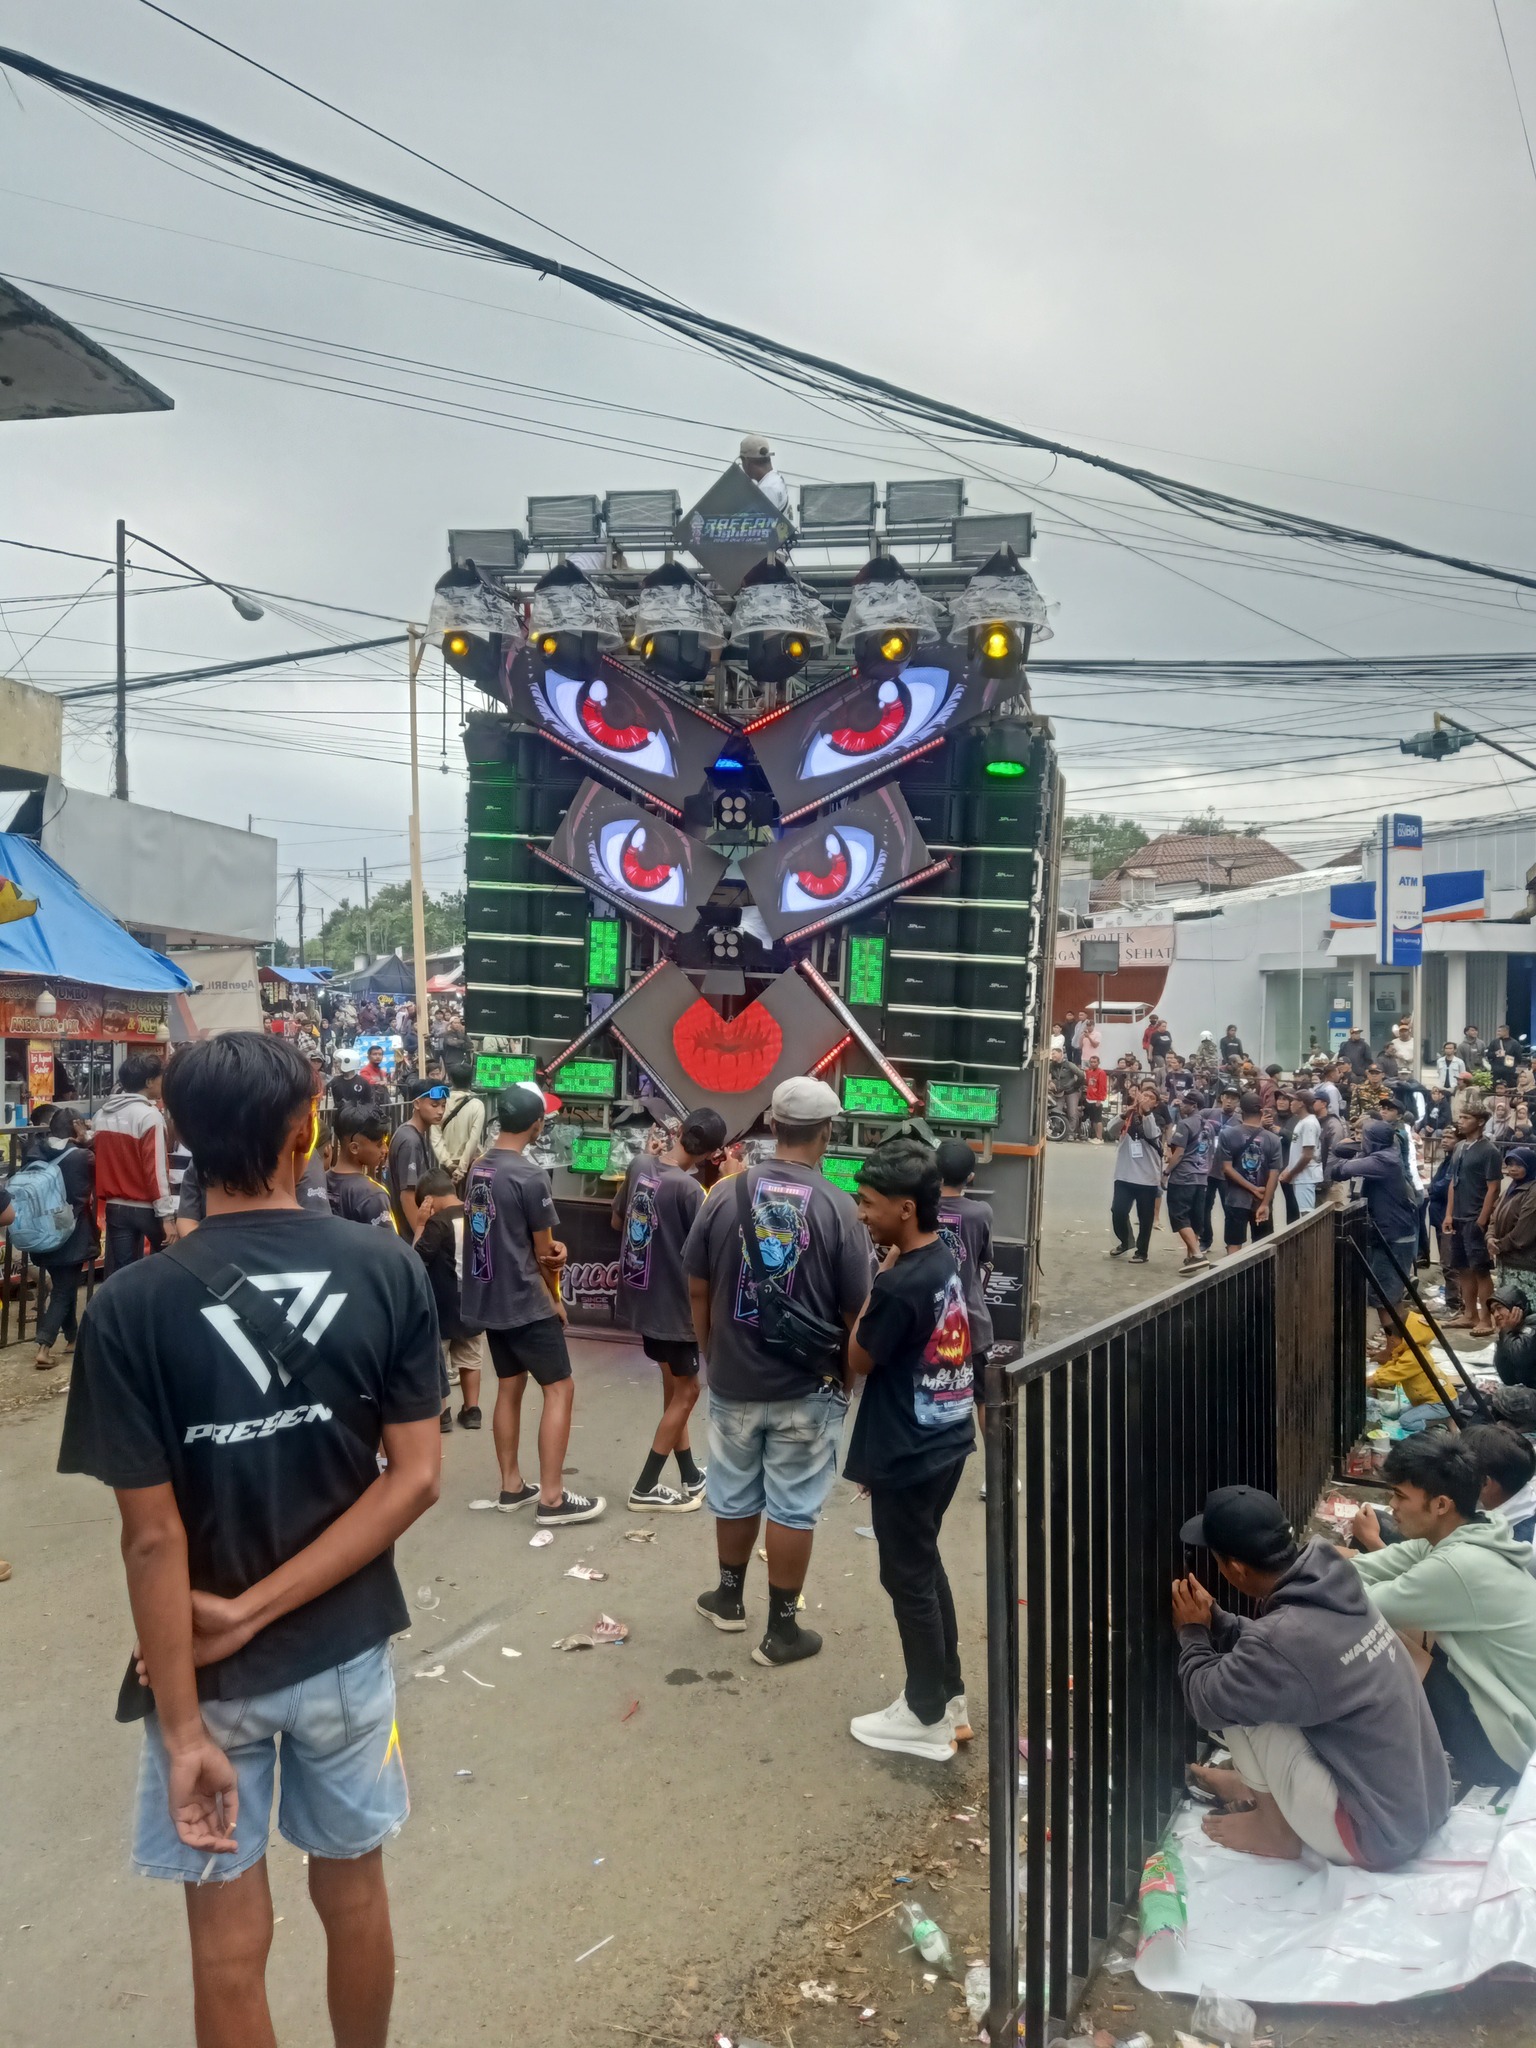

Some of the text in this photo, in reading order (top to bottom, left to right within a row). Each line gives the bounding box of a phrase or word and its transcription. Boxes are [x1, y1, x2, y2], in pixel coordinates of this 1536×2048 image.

[1398, 876, 1419, 887] ATM
[1125, 947, 1173, 960] SEHAT
[1340, 1628, 1377, 1666] WARP
